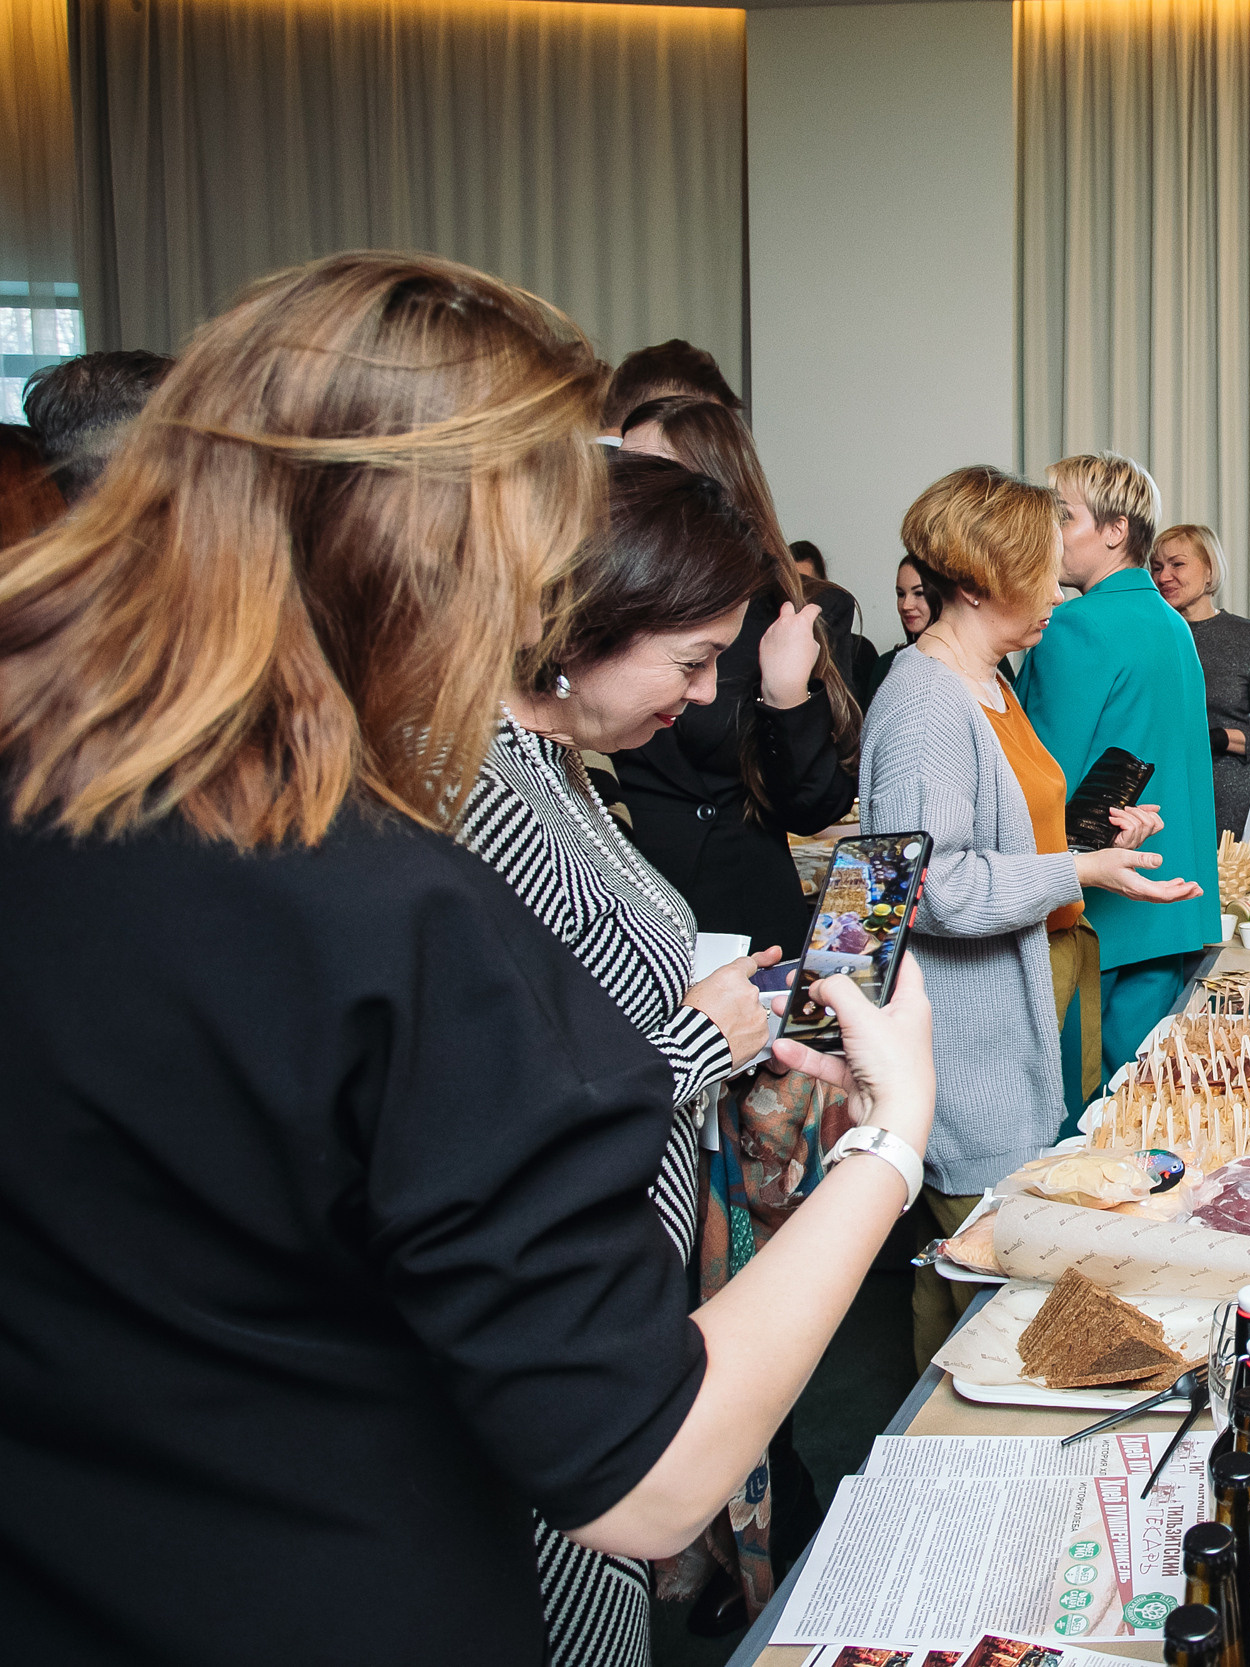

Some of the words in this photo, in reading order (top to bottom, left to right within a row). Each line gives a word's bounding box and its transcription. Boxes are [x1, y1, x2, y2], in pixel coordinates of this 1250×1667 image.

[1075, 1481, 1087, 1513] ИСТОРИЯ
[1099, 1479, 1127, 1504] Хлеб
[1070, 1509, 1081, 1532] ХЛЕБА
[1074, 1543, 1086, 1558] ГМО
[1105, 1504, 1131, 1584] ПУМПЕРНИКЕЛЬ
[1139, 1509, 1164, 1575] ПЕКАРЬ
[1162, 1505, 1184, 1577] ТИЛЬЗИТСКИЙ
